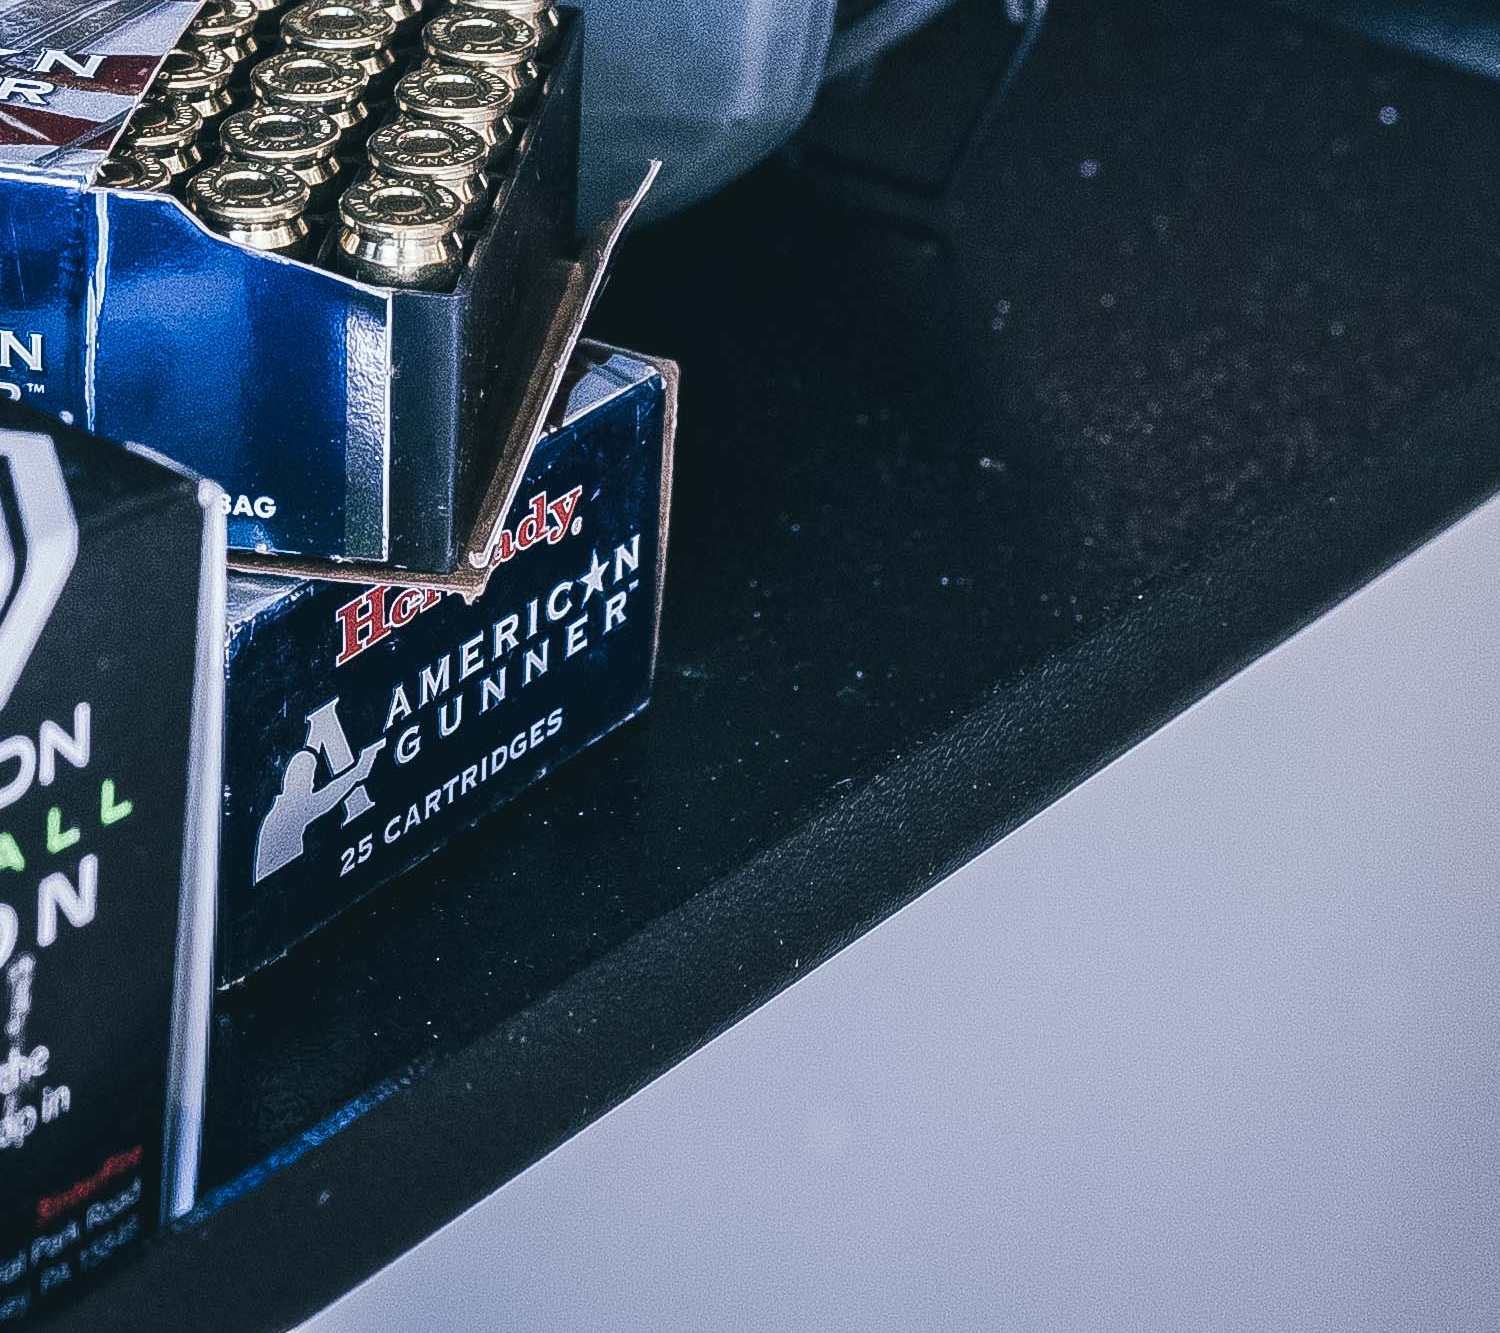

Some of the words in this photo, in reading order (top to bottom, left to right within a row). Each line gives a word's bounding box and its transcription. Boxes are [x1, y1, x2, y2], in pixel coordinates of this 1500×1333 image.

[395, 591, 630, 766] GUNNER
[340, 835, 373, 877] 25
[384, 708, 564, 844] CARTRIDGES
